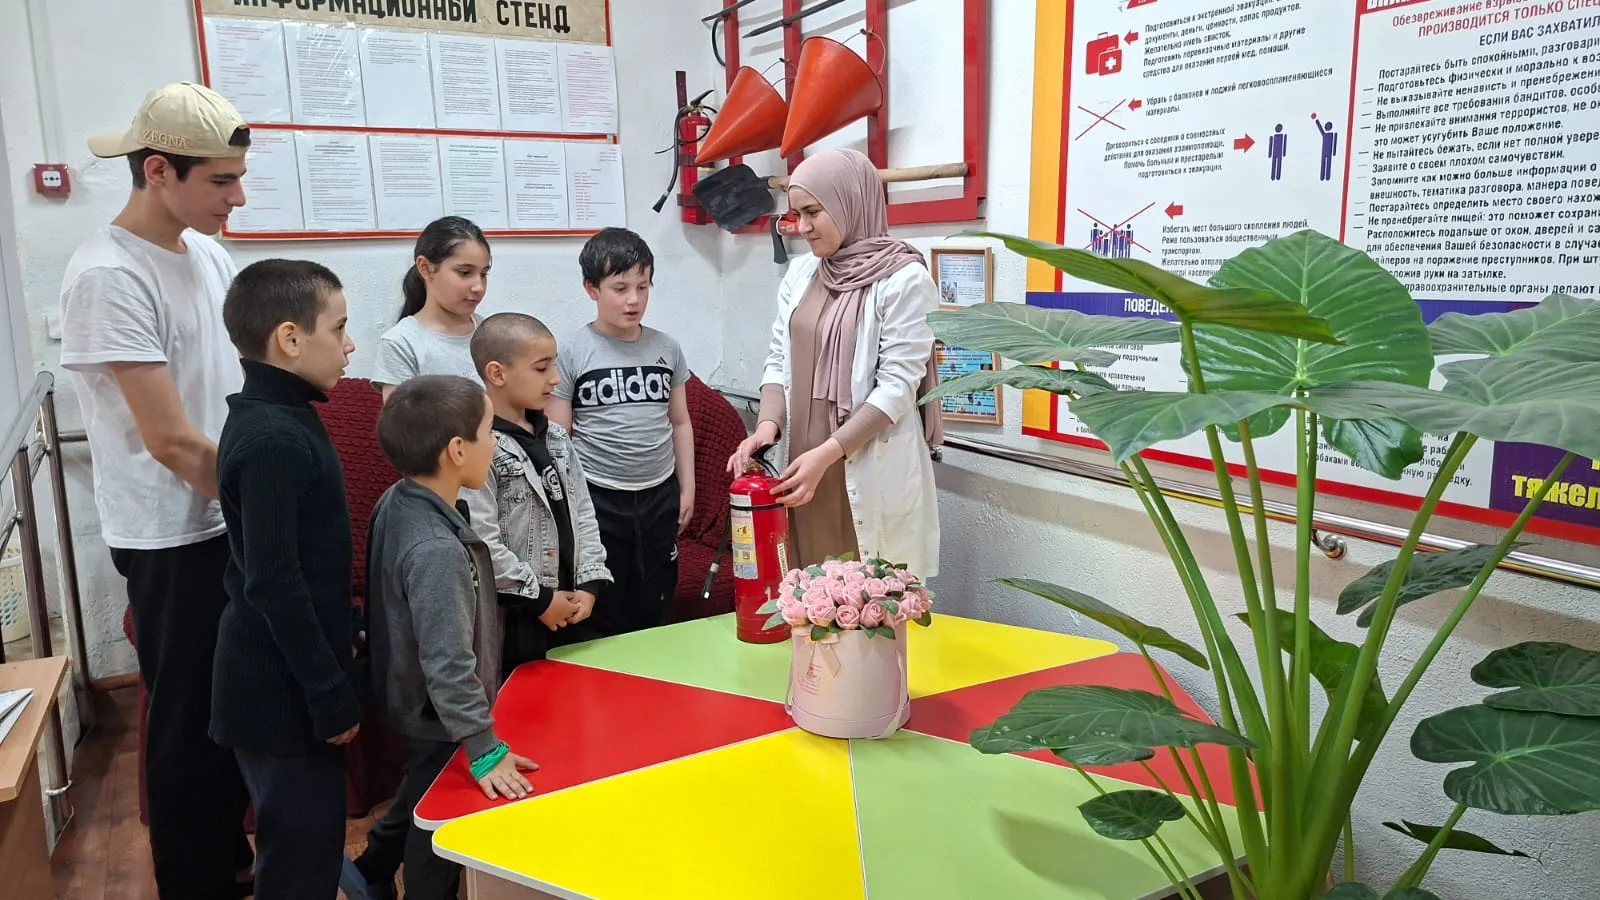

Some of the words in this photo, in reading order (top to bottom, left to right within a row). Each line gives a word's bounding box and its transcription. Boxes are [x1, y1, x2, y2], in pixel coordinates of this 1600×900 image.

[496, 0, 571, 34] СТЕНД
[1239, 11, 1260, 24] запас
[1392, 1, 1482, 27] Обезвреживание
[1418, 10, 1510, 38] ПРОИЗВОДИТСЯ
[1515, 0, 1563, 20] ТОЛЬКО
[1479, 32, 1509, 47] ЕСЛИ
[1510, 27, 1535, 42] ВАС
[1378, 77, 1446, 93] Подготовьтесь
[1448, 66, 1503, 85] физически
[1506, 66, 1512, 75] и
[1515, 58, 1569, 74] морально
[1572, 56, 1578, 65] к
[1379, 63, 1441, 80] Постарайтесь
[1444, 59, 1468, 70] быть
[1377, 96, 1388, 106] Не
[1391, 88, 1454, 104] выказывайте
[1456, 82, 1508, 97] ненависть
[1511, 80, 1516, 89] и
[1375, 123, 1386, 133] Не
[1389, 118, 1447, 133] привлекайте
[1449, 112, 1497, 126] внимания
[1573, 101, 1587, 112] не
[1376, 105, 1431, 121] Выполняйте
[1433, 103, 1449, 114] все
[1452, 96, 1511, 113] требования
[1374, 137, 1388, 148] это
[1390, 135, 1421, 146] может
[1422, 129, 1469, 145] усугубить
[1471, 126, 1500, 138] Ваше
[1502, 120, 1564, 134] положение.
[1373, 150, 1385, 161] Не
[1387, 147, 1434, 159] пытайтесь
[1477, 141, 1501, 152] если
[1503, 138, 1522, 149] нет
[1524, 133, 1563, 147] полной
[1371, 176, 1419, 187] Запомните
[1421, 175, 1437, 183] как
[1439, 171, 1471, 182] можно
[1473, 168, 1513, 181] больше
[1516, 163, 1587, 178] информации
[1590, 163, 1597, 173] о
[1372, 162, 1408, 174] Заявите
[1410, 161, 1416, 171] о
[1418, 159, 1447, 170] своем
[1449, 156, 1486, 167] плохом
[1422, 186, 1466, 198] тематика
[1526, 180, 1568, 192] манера
[1369, 202, 1430, 214] Постарайтесь
[1432, 199, 1490, 212] определить
[1492, 197, 1524, 208] место
[1526, 195, 1563, 206] своего
[1368, 216, 1380, 226] Не
[1381, 213, 1449, 227] пренебрегайте
[1488, 212, 1505, 222] это
[1507, 210, 1555, 221] поможет
[1367, 228, 1436, 239] Расположитесь
[1438, 227, 1488, 239] подальше
[1490, 227, 1503, 237] от
[1534, 223, 1574, 237] дверей
[1577, 225, 1583, 234] и
[1366, 244, 1382, 254] для
[1384, 241, 1442, 252] обеспечения
[1445, 240, 1477, 251] Вашей
[1479, 239, 1551, 250] безопасности
[1554, 240, 1561, 250] в
[1413, 257, 1424, 265] на
[1426, 256, 1479, 267] поражение
[1558, 253, 1581, 266] При
[1424, 270, 1445, 280] руки
[1447, 270, 1459, 279] на
[1461, 269, 1507, 280] затылке.
[1509, 284, 1549, 295] органы
[1552, 285, 1596, 296] делают
[577, 366, 671, 407] adidas
